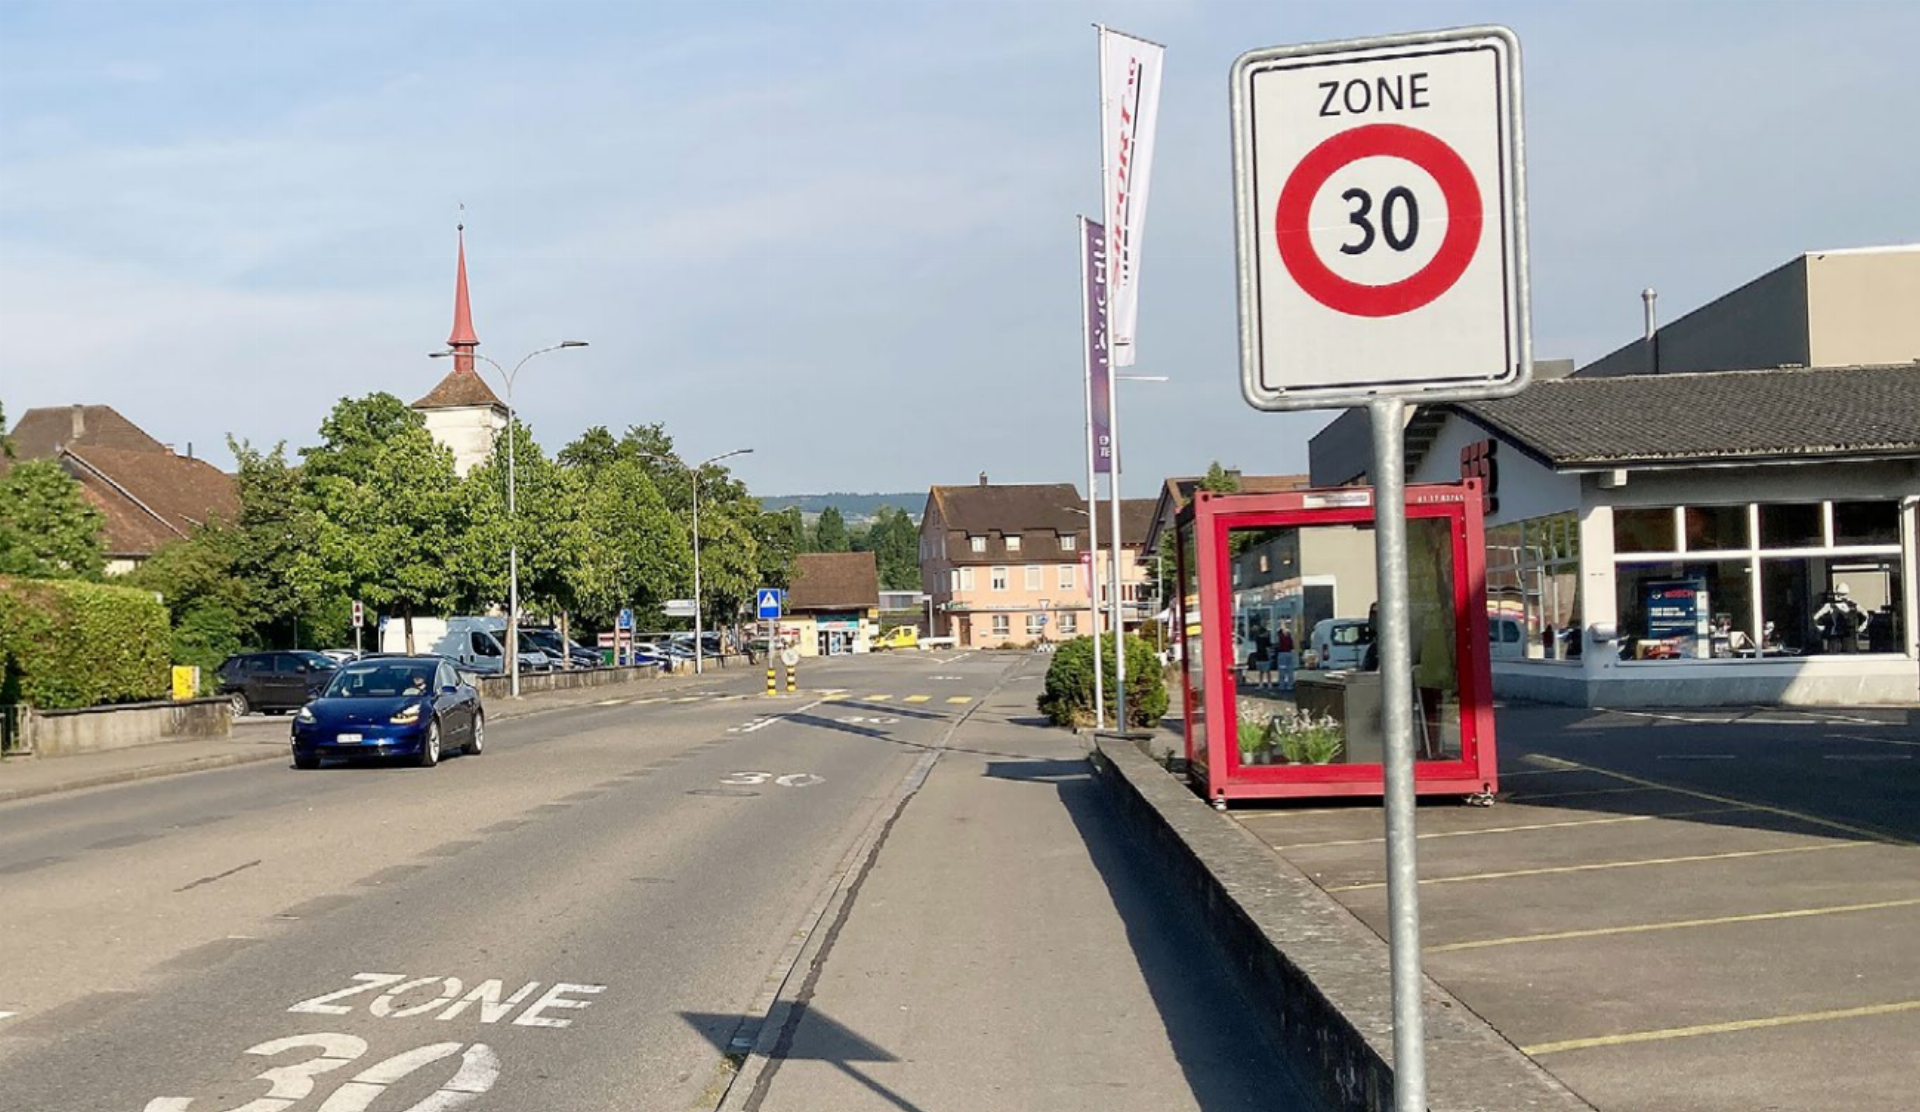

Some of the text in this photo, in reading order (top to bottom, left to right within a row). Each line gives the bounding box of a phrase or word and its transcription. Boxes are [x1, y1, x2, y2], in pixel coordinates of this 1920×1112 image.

[1318, 72, 1430, 117] ZONE
[1340, 186, 1419, 255] 30
[719, 770, 827, 787] 30
[287, 973, 607, 1028] ZONE
[143, 1032, 500, 1112] 30
